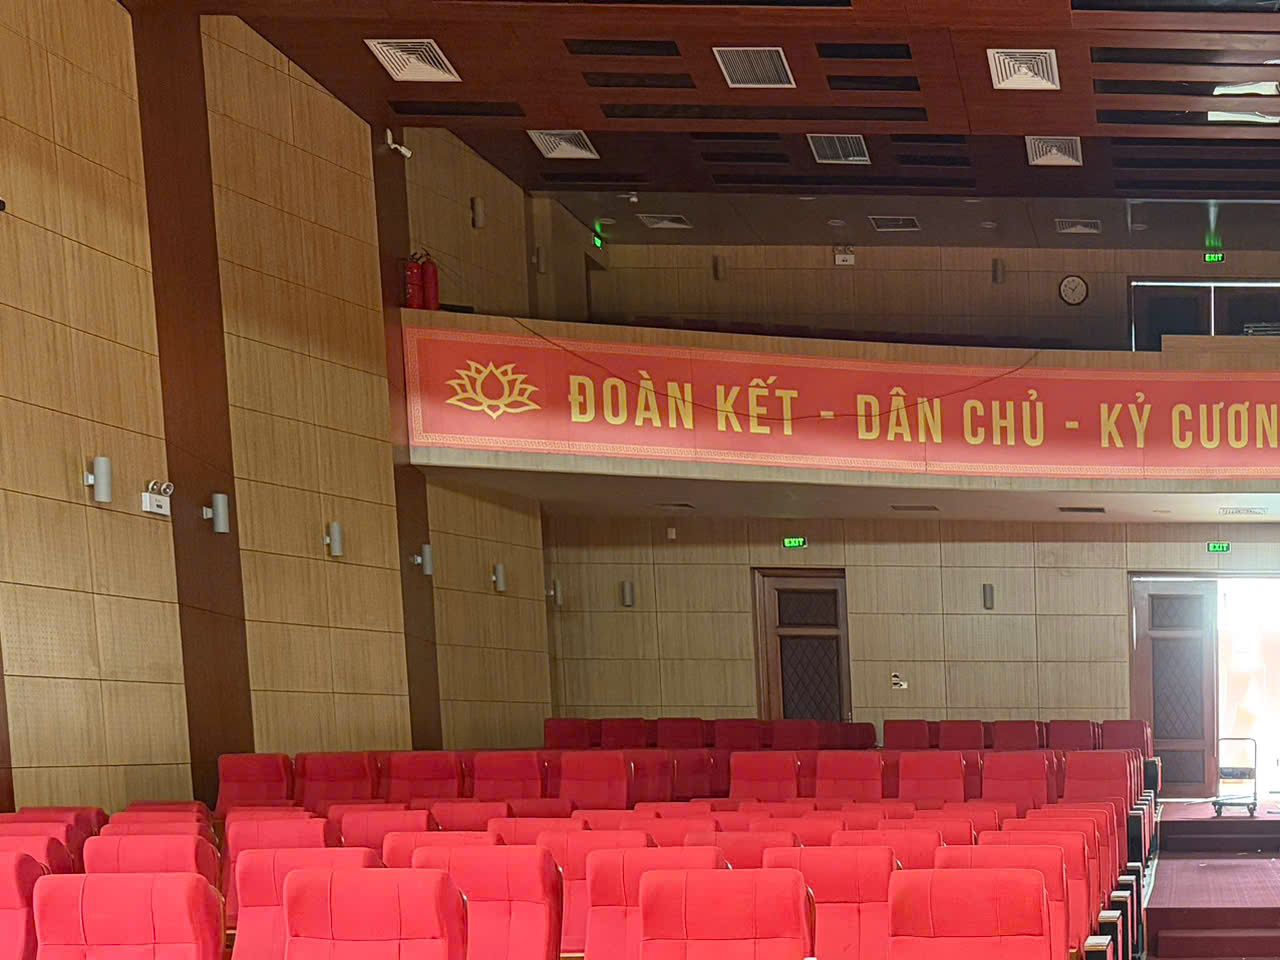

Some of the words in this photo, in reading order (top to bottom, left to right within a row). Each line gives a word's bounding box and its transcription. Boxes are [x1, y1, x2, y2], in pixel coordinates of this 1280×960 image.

[1205, 254, 1223, 262] EXIT
[568, 370, 694, 430] ĐOÀN
[717, 376, 798, 436] KẾT
[820, 410, 834, 419] -
[858, 386, 943, 444] DÂN
[964, 389, 1045, 447] CHỦ
[1065, 420, 1080, 429] -
[1100, 391, 1153, 449] KỶ
[783, 537, 805, 547] EXIT
[1209, 543, 1228, 551] EXIT
